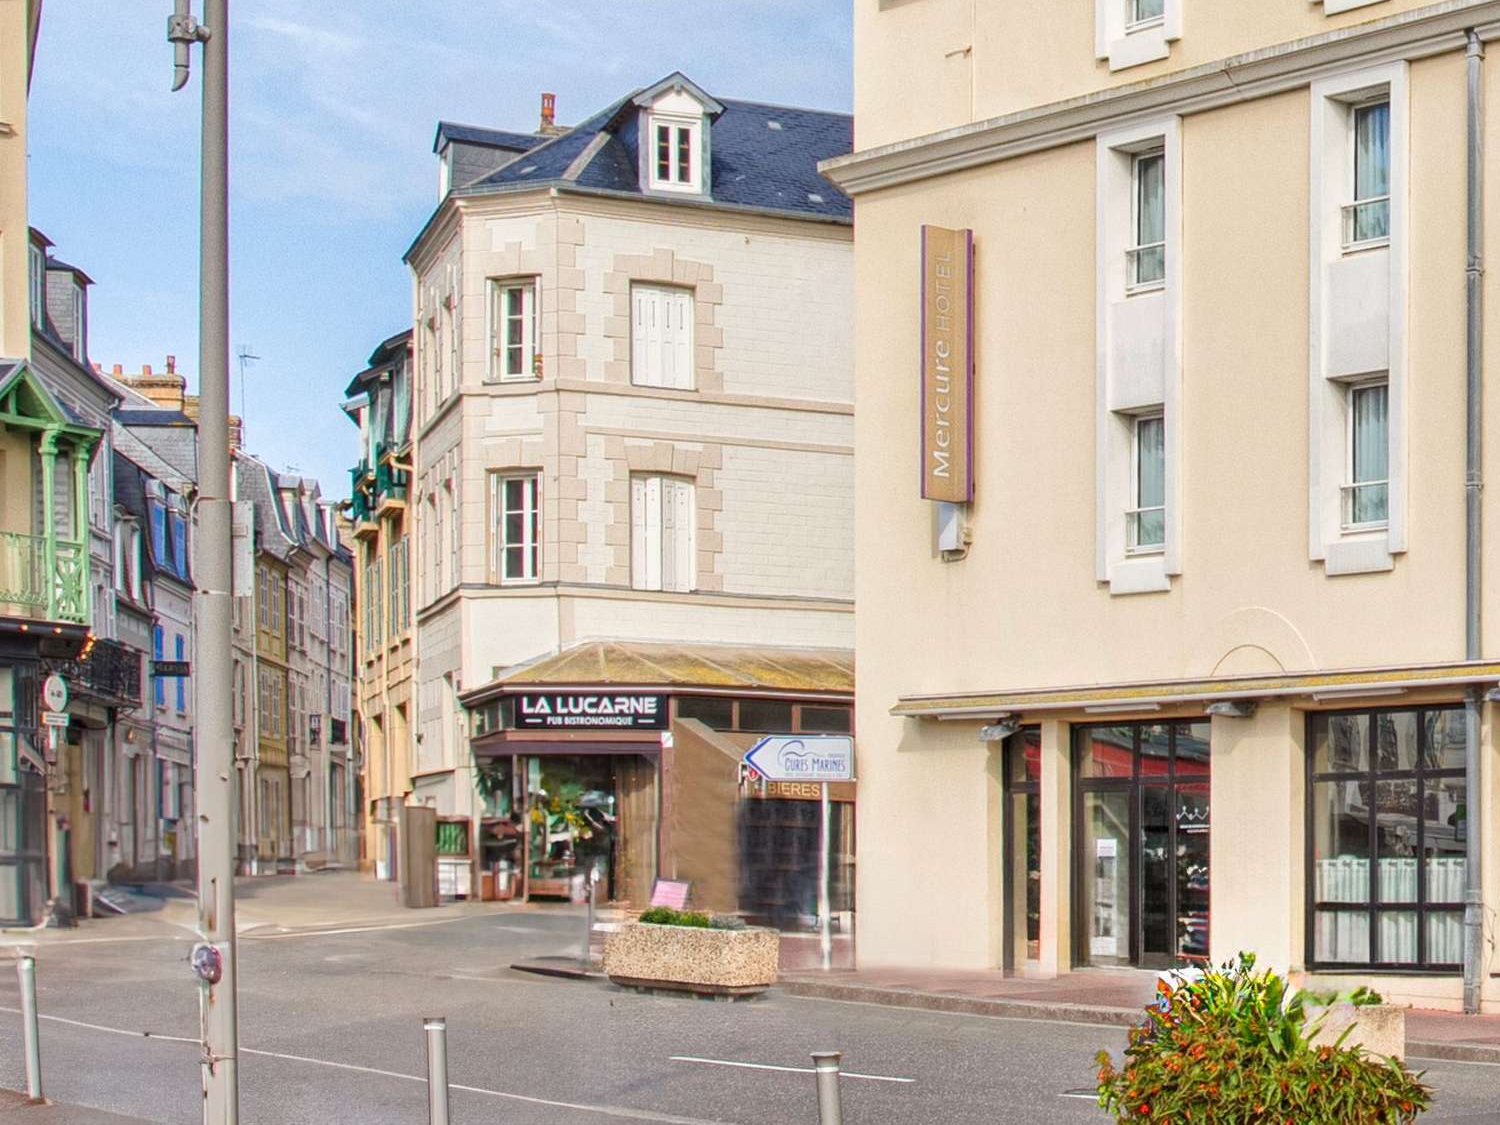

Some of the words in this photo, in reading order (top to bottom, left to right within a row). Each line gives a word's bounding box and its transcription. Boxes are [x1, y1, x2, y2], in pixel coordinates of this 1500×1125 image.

[934, 252, 953, 332] HOTEL
[931, 340, 951, 478] Mercure
[522, 696, 552, 714] LA
[556, 696, 657, 714] LUCARNE
[546, 716, 563, 725] PUB
[564, 716, 633, 725] BISTRONOMIQUE
